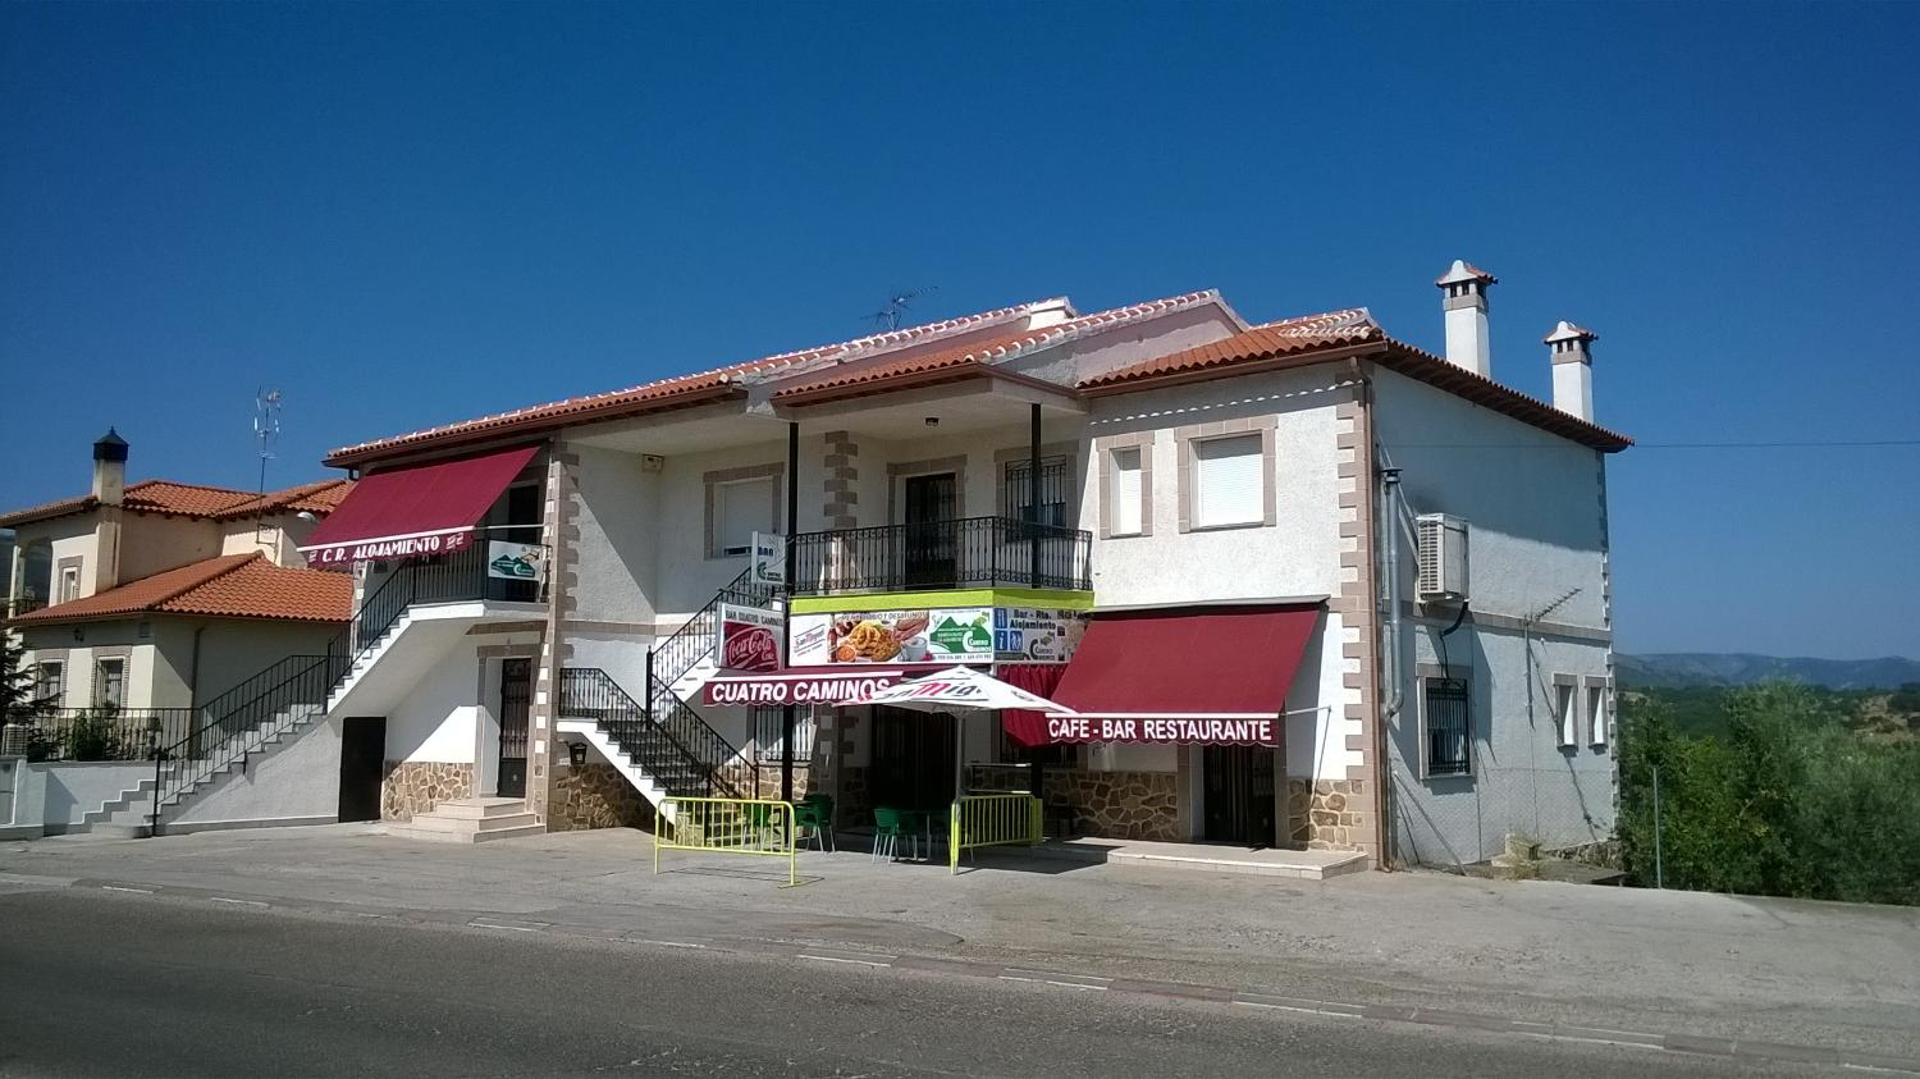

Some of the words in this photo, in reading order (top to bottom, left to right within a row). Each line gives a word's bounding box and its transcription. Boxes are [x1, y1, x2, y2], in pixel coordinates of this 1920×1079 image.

[352, 536, 440, 558] ALOJAMIENTO
[1014, 609, 1028, 618] Bar
[1010, 619, 1056, 630] Alojamiento
[712, 683, 788, 701] CUATRO
[793, 678, 890, 700] CAMINOS
[1144, 720, 1272, 740] RESTAURANTE
